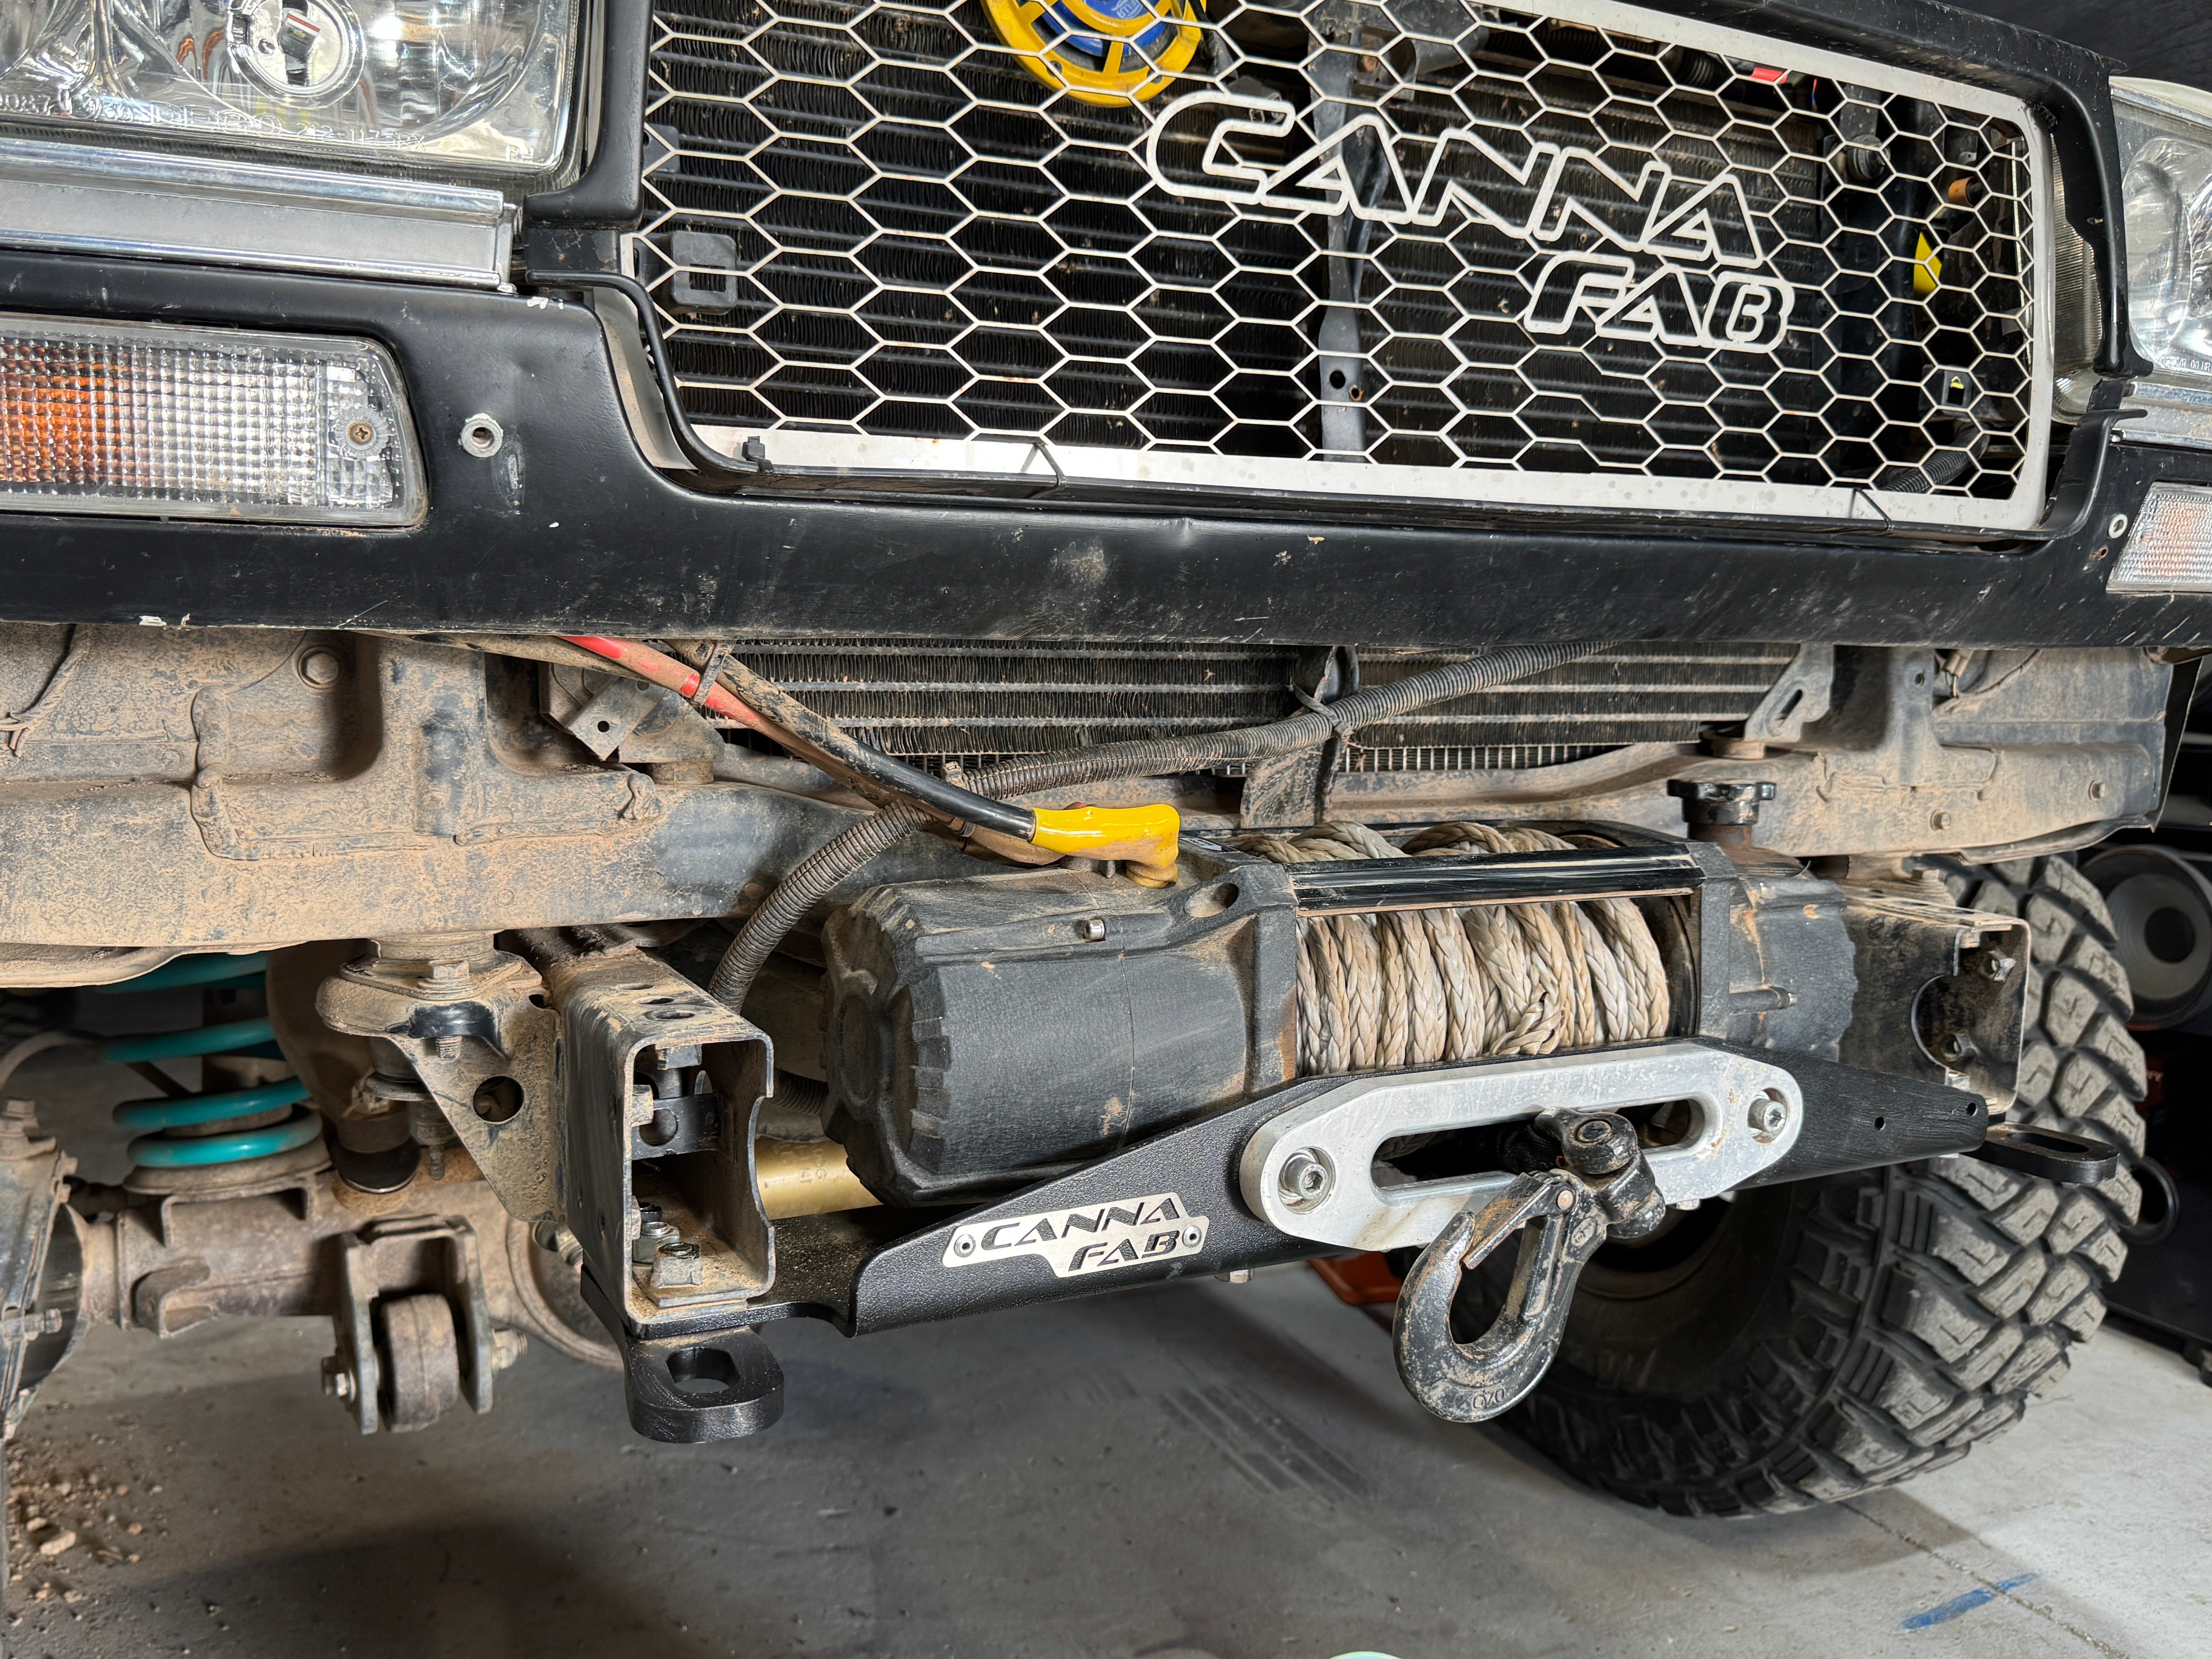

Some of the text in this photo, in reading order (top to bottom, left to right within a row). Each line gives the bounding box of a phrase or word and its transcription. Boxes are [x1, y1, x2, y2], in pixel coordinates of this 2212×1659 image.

[1147, 91, 1762, 267] CANNA
[1525, 251, 1794, 353] FAB
[981, 1198, 1180, 1250] CANNA
[1068, 1230, 1180, 1272] FAB
